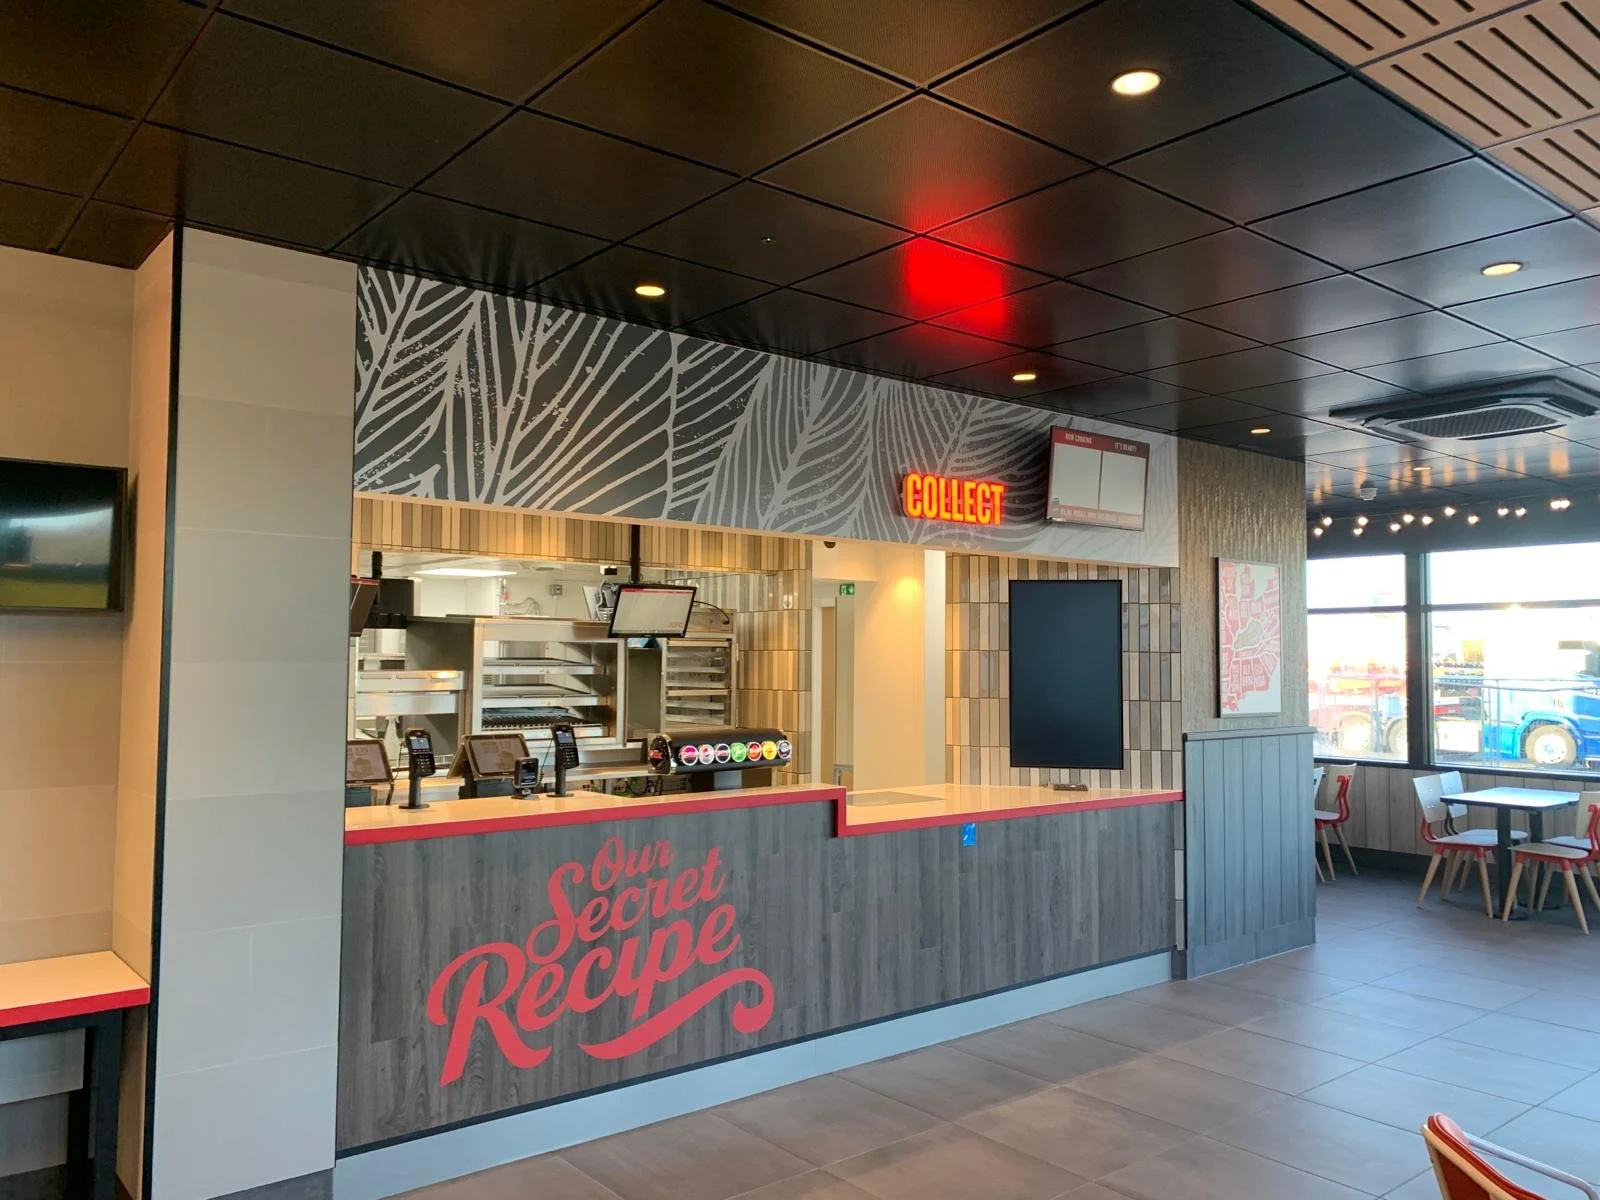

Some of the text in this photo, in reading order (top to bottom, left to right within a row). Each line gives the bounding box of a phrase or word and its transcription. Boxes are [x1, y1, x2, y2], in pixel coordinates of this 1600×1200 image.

[904, 472, 1006, 526] COLLECT
[525, 846, 727, 965] Secret
[591, 836, 676, 892] Our
[426, 903, 741, 1088] Recipe
